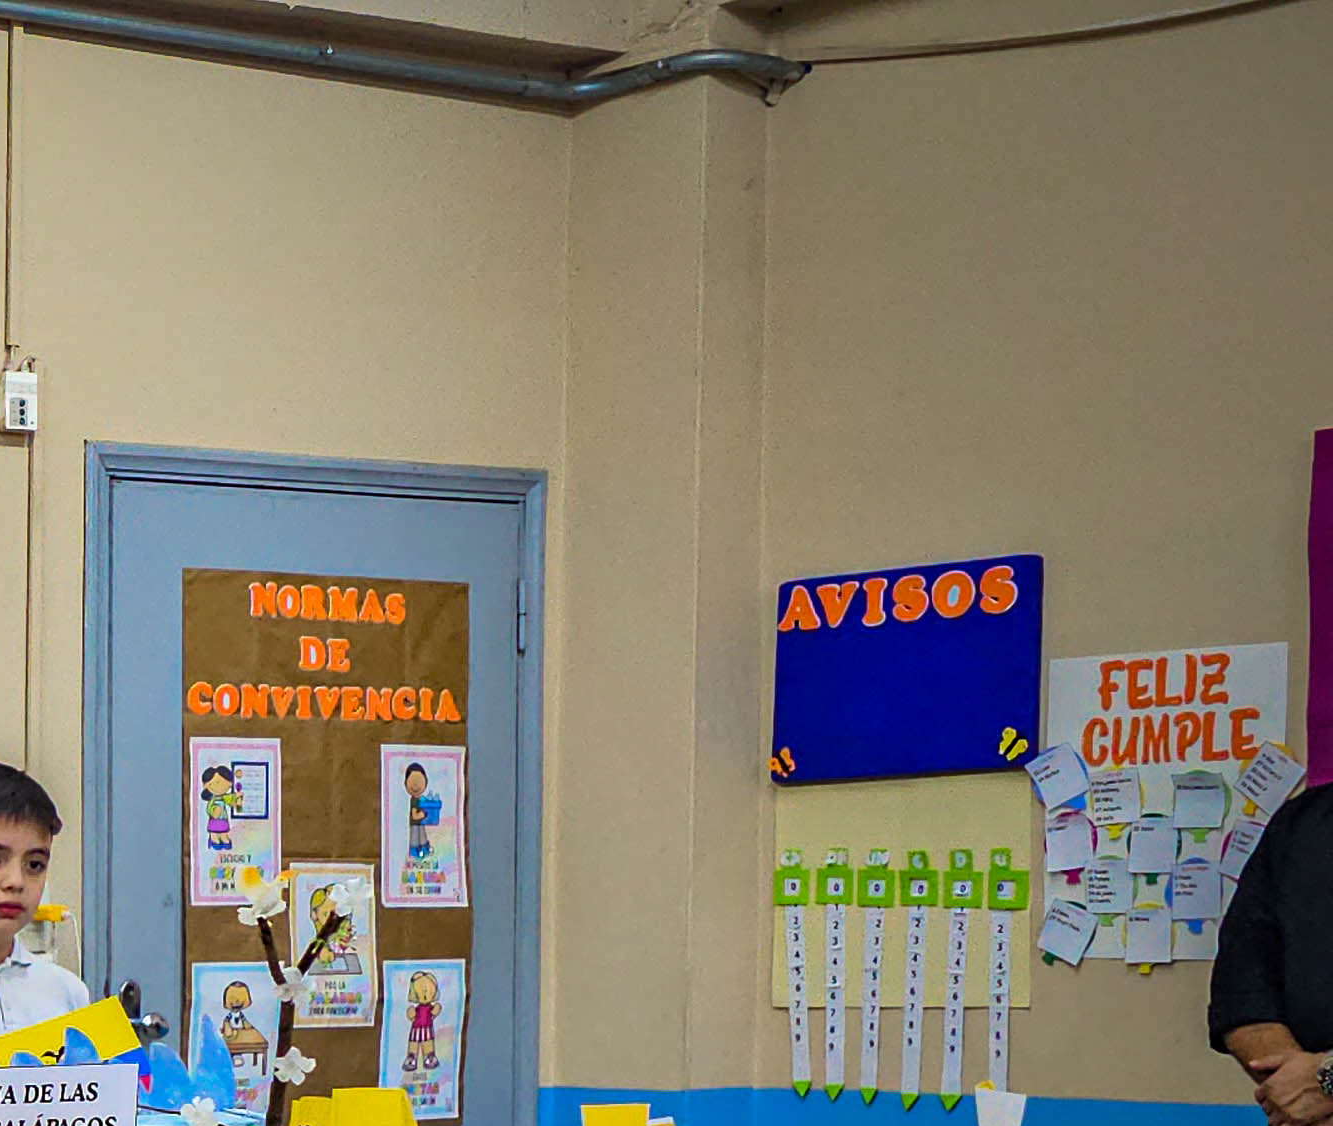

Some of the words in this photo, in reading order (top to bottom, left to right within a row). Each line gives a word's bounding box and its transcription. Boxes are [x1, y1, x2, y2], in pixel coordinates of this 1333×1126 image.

[248, 581, 406, 625] NORMAS
[777, 564, 1018, 632] AVISOS
[298, 635, 351, 673] DE
[187, 681, 462, 722] CONVIVENCIA
[1097, 653, 1231, 711] FELIZ
[1081, 707, 1262, 767] CUMPLE
[23, 1083, 54, 1104] DE
[59, 1082, 99, 1103] LAS
